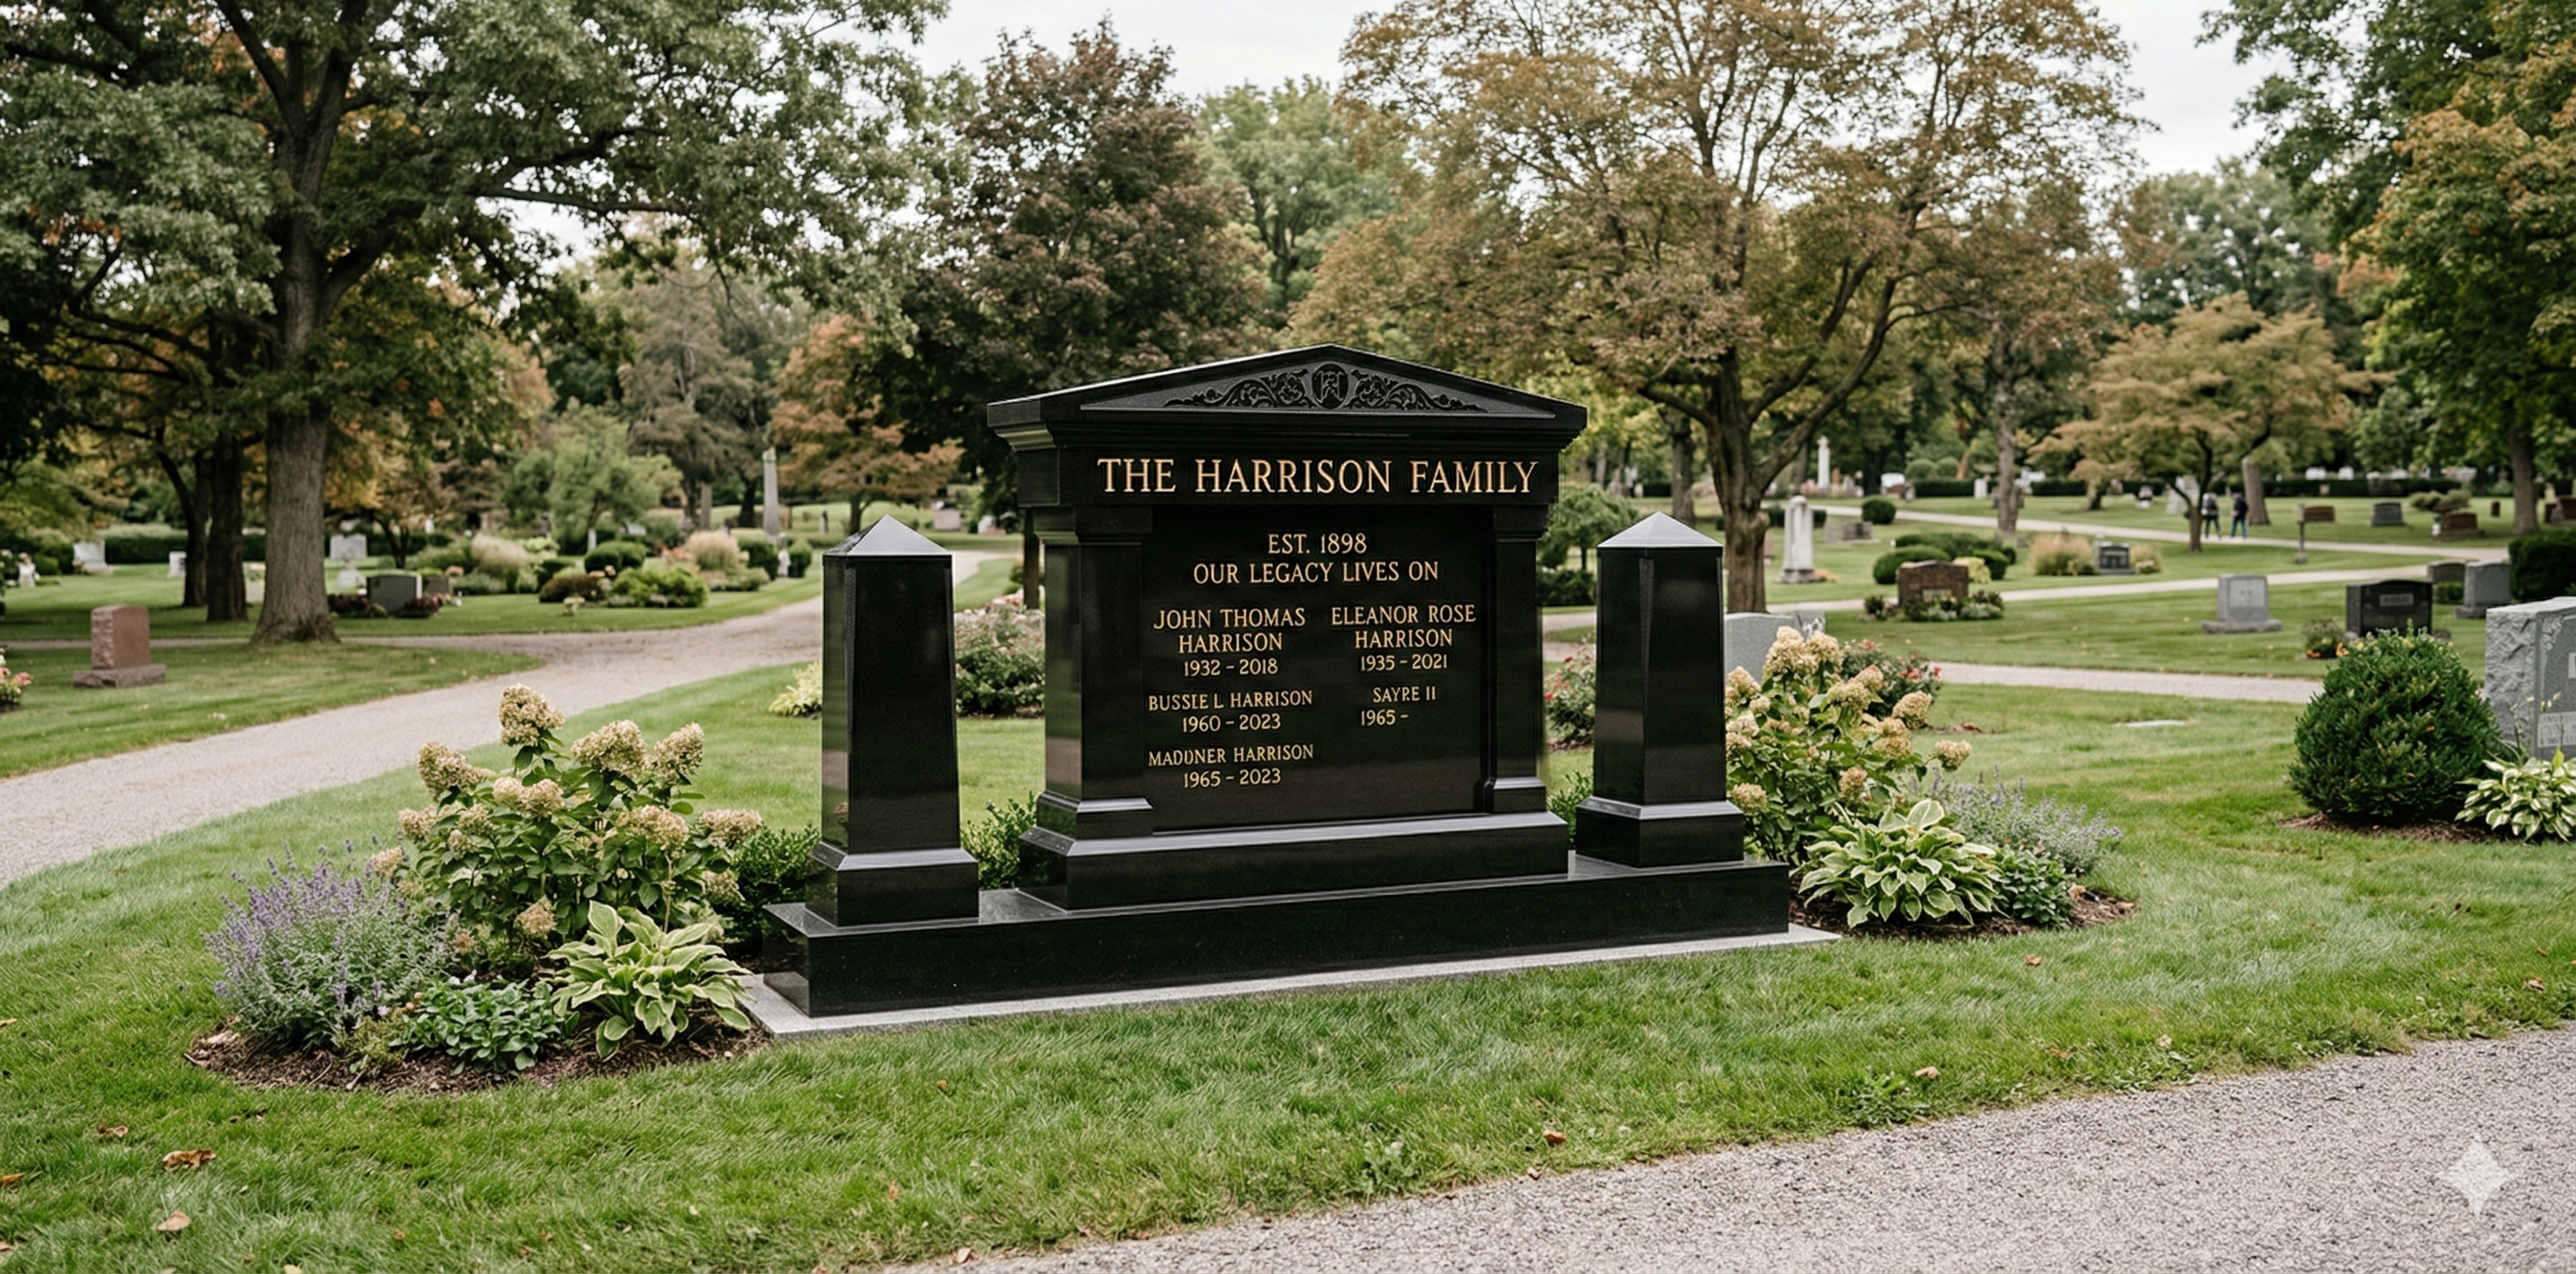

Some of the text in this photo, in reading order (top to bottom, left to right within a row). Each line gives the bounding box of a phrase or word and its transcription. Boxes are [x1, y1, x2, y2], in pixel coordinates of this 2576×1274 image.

[1098, 458, 1537, 494] THE HARRISON FAMILY
[1269, 533, 1367, 554] EST. 1898
[1194, 561, 1438, 584] OUR LEGACY LIVES ON
[1154, 607, 1306, 629] JOHN THOMAS
[1331, 604, 1476, 625] ELEANOR ROSE
[1178, 633, 1282, 653] HARRISON
[1355, 628, 1453, 649] HARRISON
[1184, 660, 1221, 677] 1932
[1239, 658, 1278, 675] 2018
[1361, 655, 1395, 672] 1935
[1412, 653, 1447, 670] 2021
[1214, 694, 1224, 710] L
[1230, 690, 1313, 708] HARRISON
[1373, 687, 1420, 703] SAYRE
[1183, 714, 1222, 733] 1960
[1239, 713, 1281, 731] 2023
[1361, 710, 1396, 725] 1965
[1233, 744, 1314, 763] HARRISON
[1184, 770, 1221, 788] 1965
[1239, 767, 1281, 786] 2023
